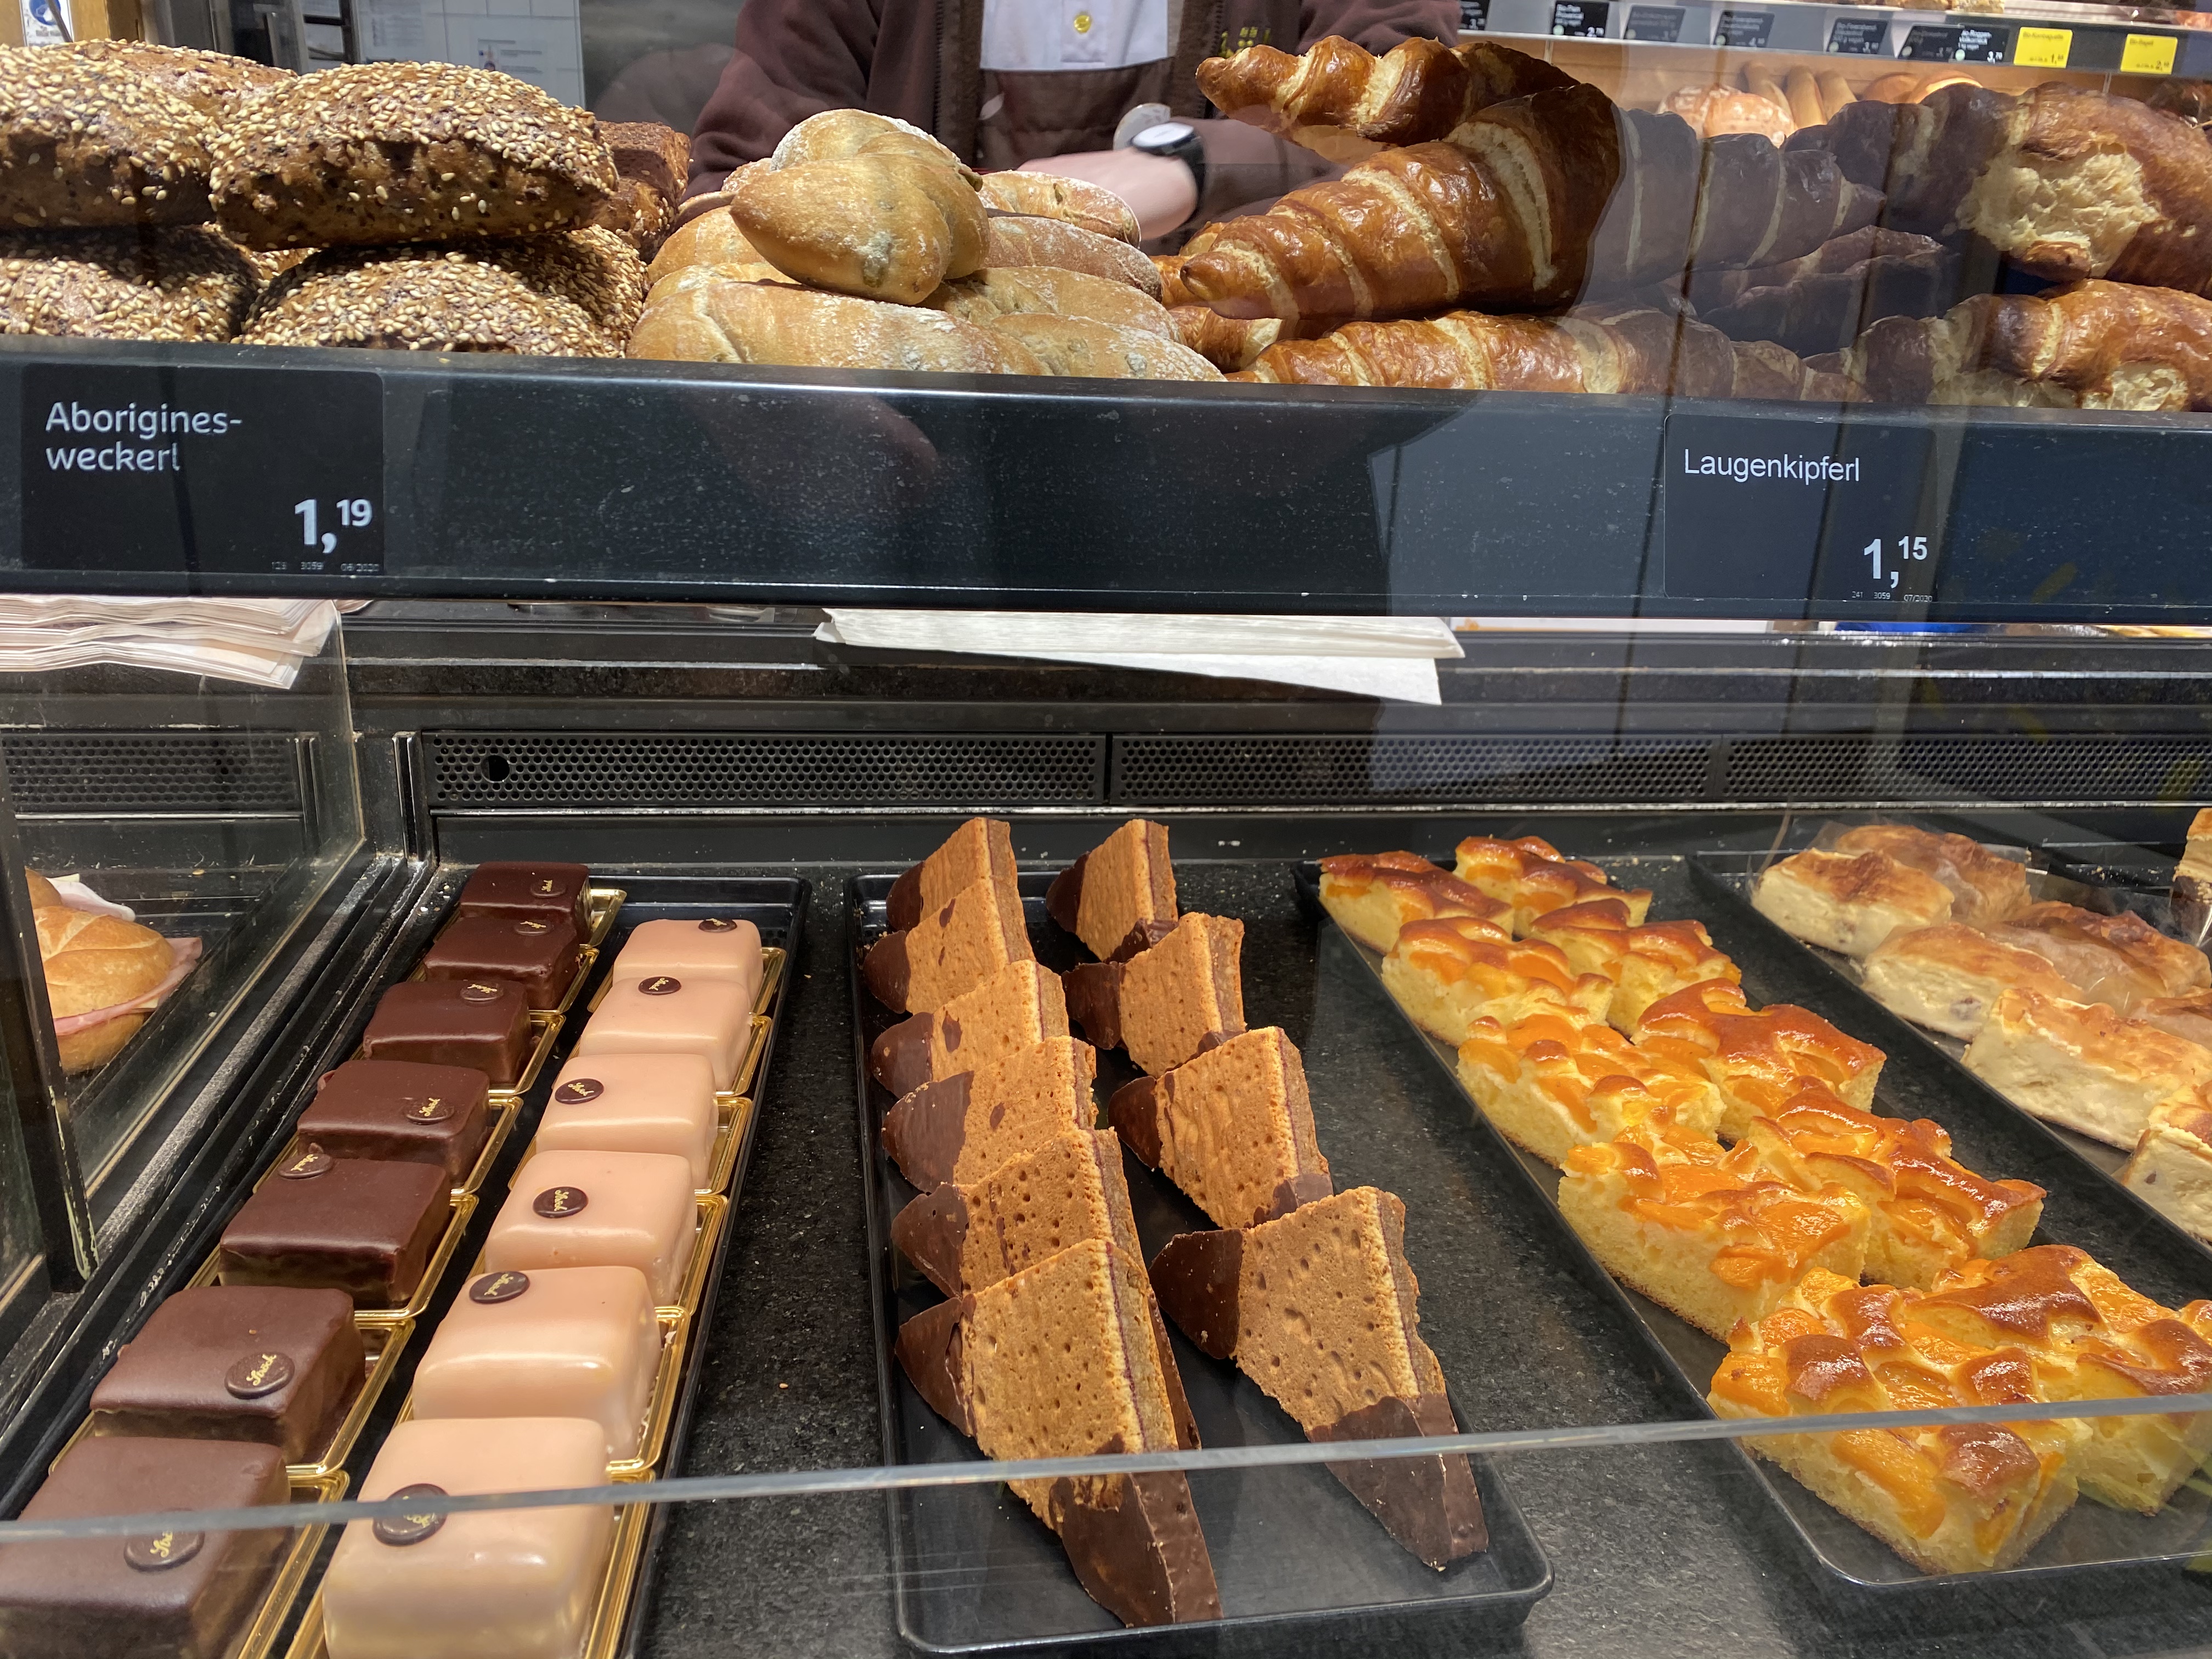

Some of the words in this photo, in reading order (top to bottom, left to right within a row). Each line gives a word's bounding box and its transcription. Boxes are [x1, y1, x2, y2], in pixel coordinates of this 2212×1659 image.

[45, 401, 242, 439] Aborigines-
[45, 441, 180, 471] weckerl
[1684, 448, 1860, 486] Laugenkipferl
[1873, 591, 1891, 600] 3059
